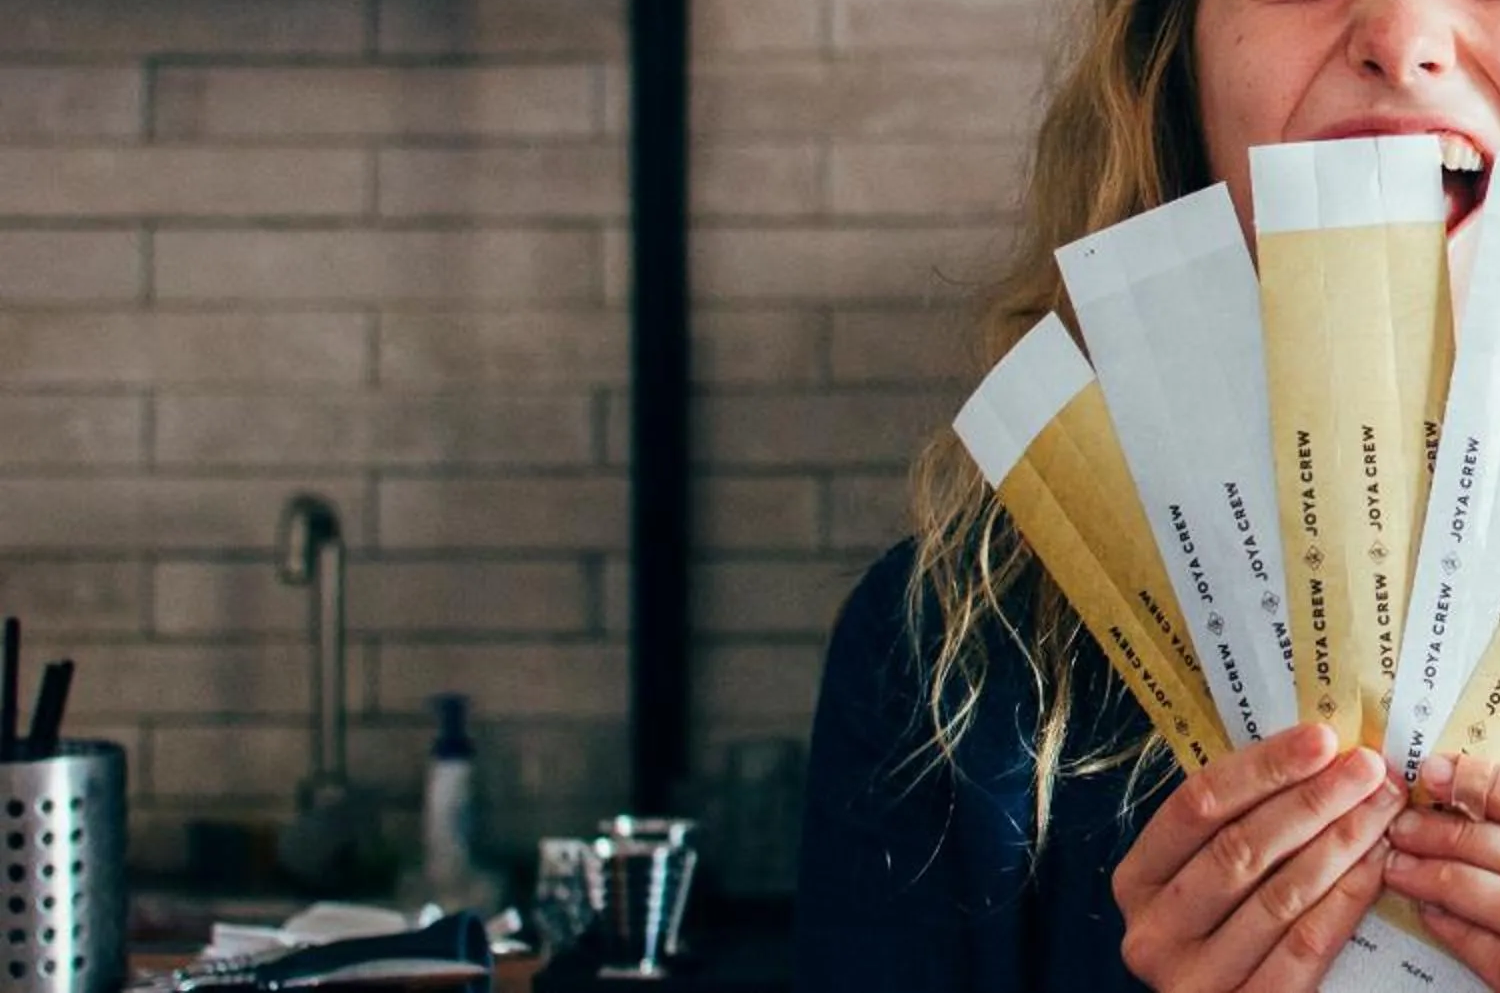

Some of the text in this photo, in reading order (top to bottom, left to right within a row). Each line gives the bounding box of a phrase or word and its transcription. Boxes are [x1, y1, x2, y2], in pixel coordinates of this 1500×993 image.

[1297, 430, 1318, 537] JOYA CREW
[1361, 425, 1383, 532] JOYA CREW
[1450, 437, 1480, 544] JOYA CREW
[1169, 504, 1213, 604] JOYA CREW
[1224, 482, 1268, 581] JOYA CREW
[1138, 591, 1171, 634] CREW
[1309, 579, 1331, 686] JOYA CREW
[1375, 574, 1395, 680] JOYA CREW
[1423, 582, 1452, 690] JOYA CREW
[1108, 626, 1172, 709] JOYA CREW
[1217, 643, 1262, 742] JOYA CREW
[1404, 730, 1425, 783] CREW
